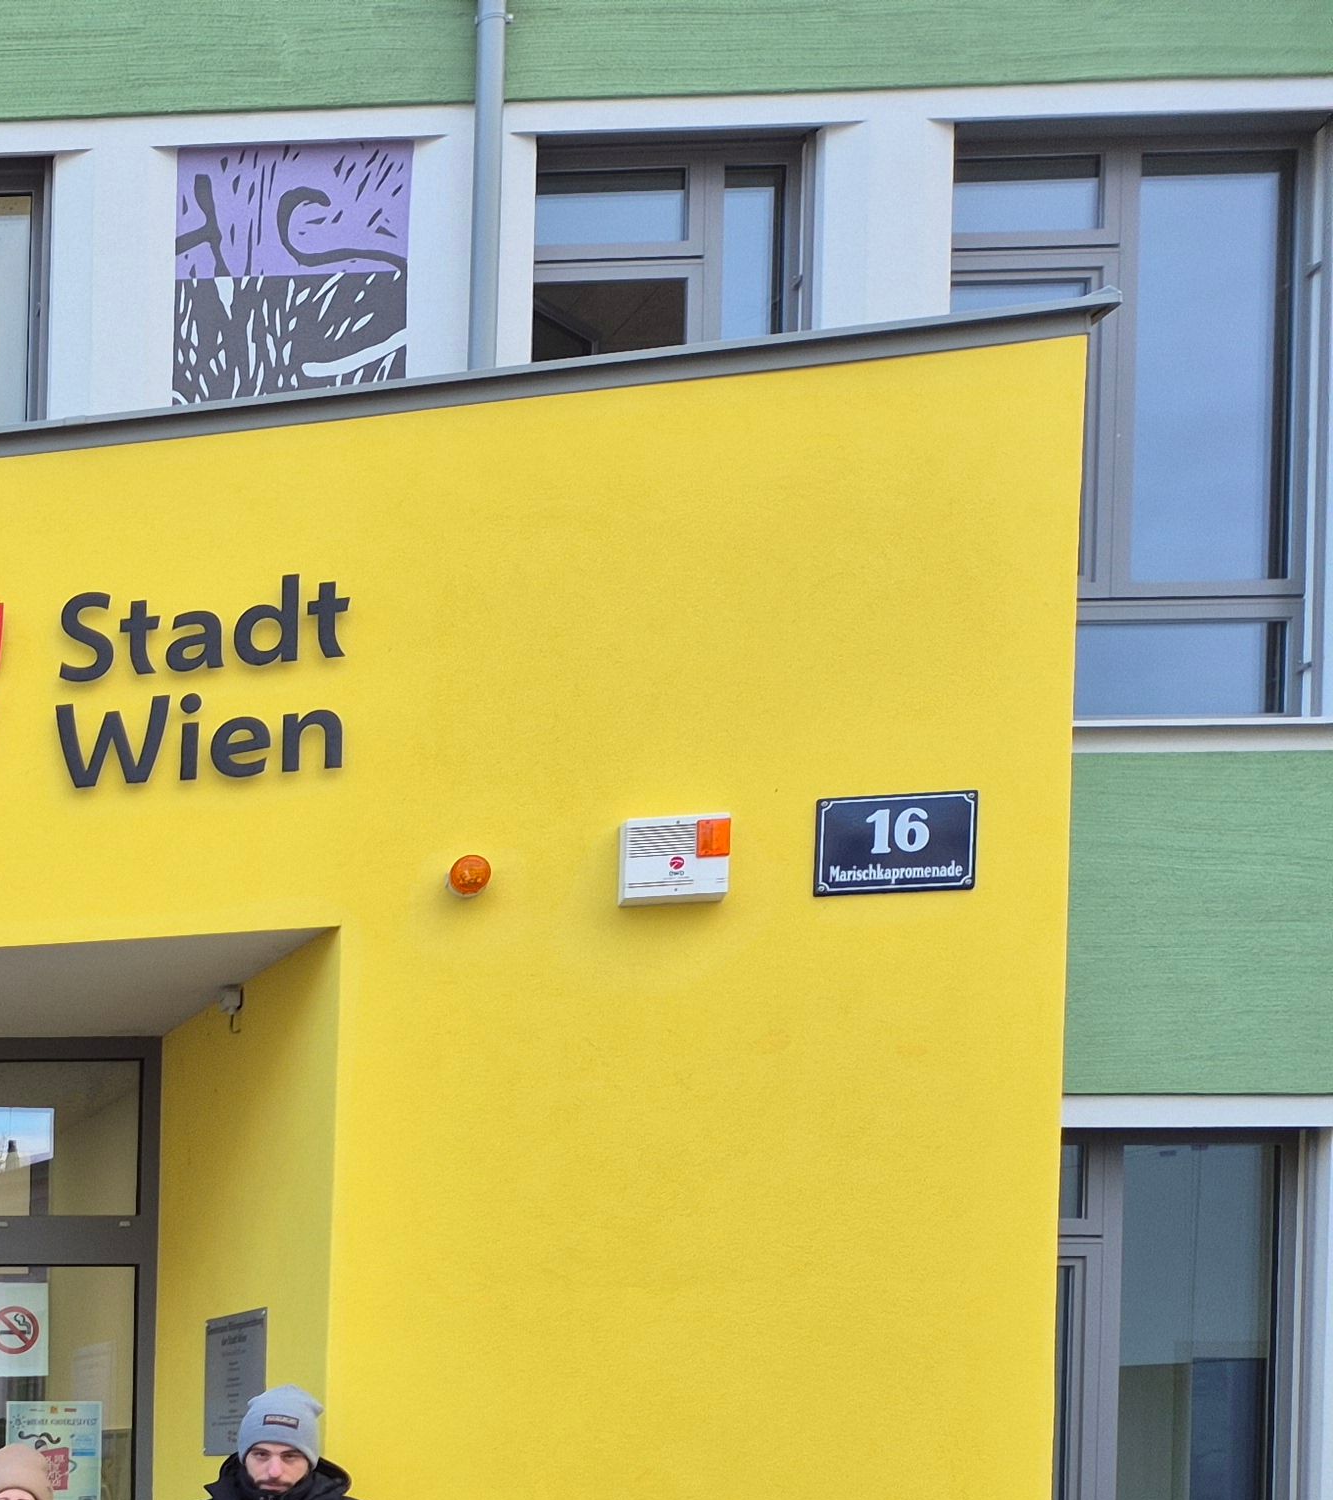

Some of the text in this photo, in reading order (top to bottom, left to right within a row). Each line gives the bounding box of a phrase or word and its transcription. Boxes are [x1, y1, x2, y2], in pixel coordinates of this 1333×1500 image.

[59, 574, 350, 682] Stadt
[55, 693, 343, 788] Wien
[866, 807, 930, 854] 16
[829, 860, 964, 883] Marischkapromenade
